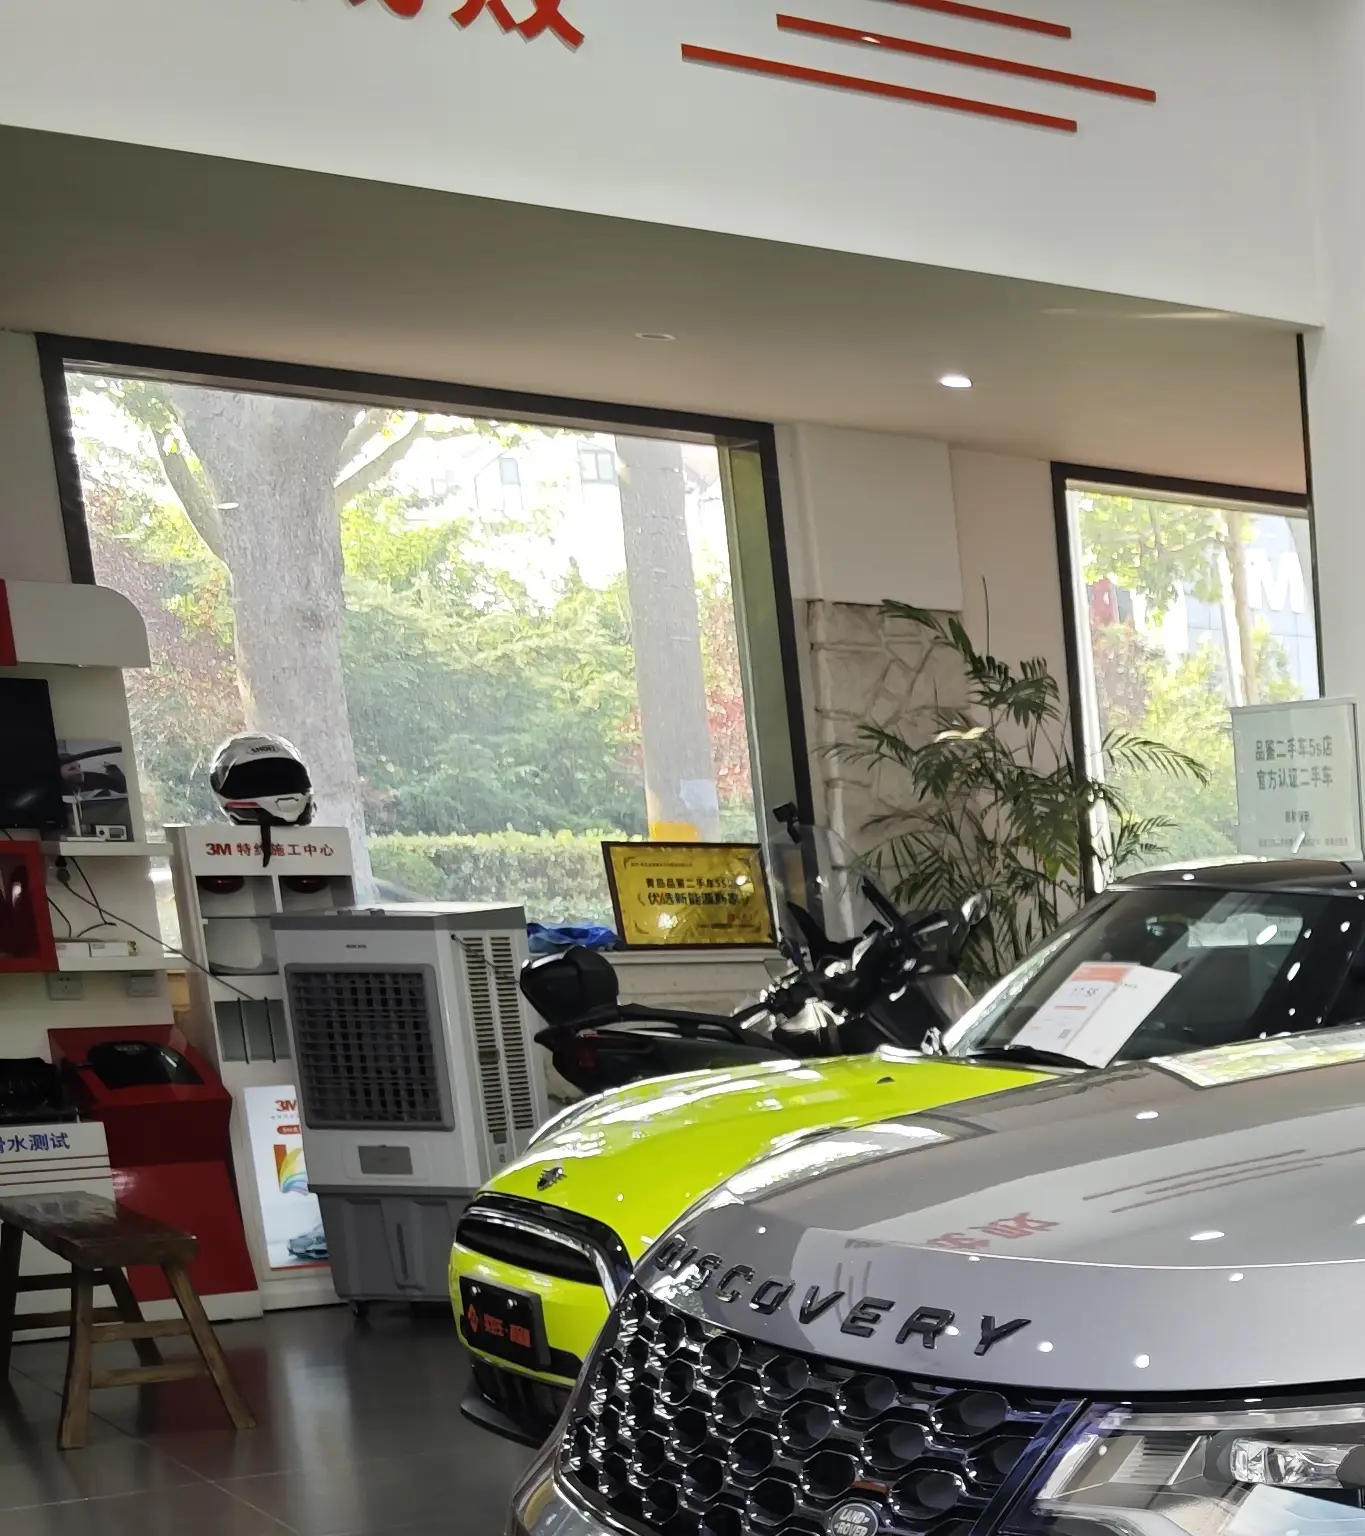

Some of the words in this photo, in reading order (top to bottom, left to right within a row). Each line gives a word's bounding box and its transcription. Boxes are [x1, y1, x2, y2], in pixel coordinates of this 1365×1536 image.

[1256, 765, 1333, 790] 官方认证二手车
[205, 843, 232, 856] 3M
[655, 1233, 1032, 1356] DISCOVERY
